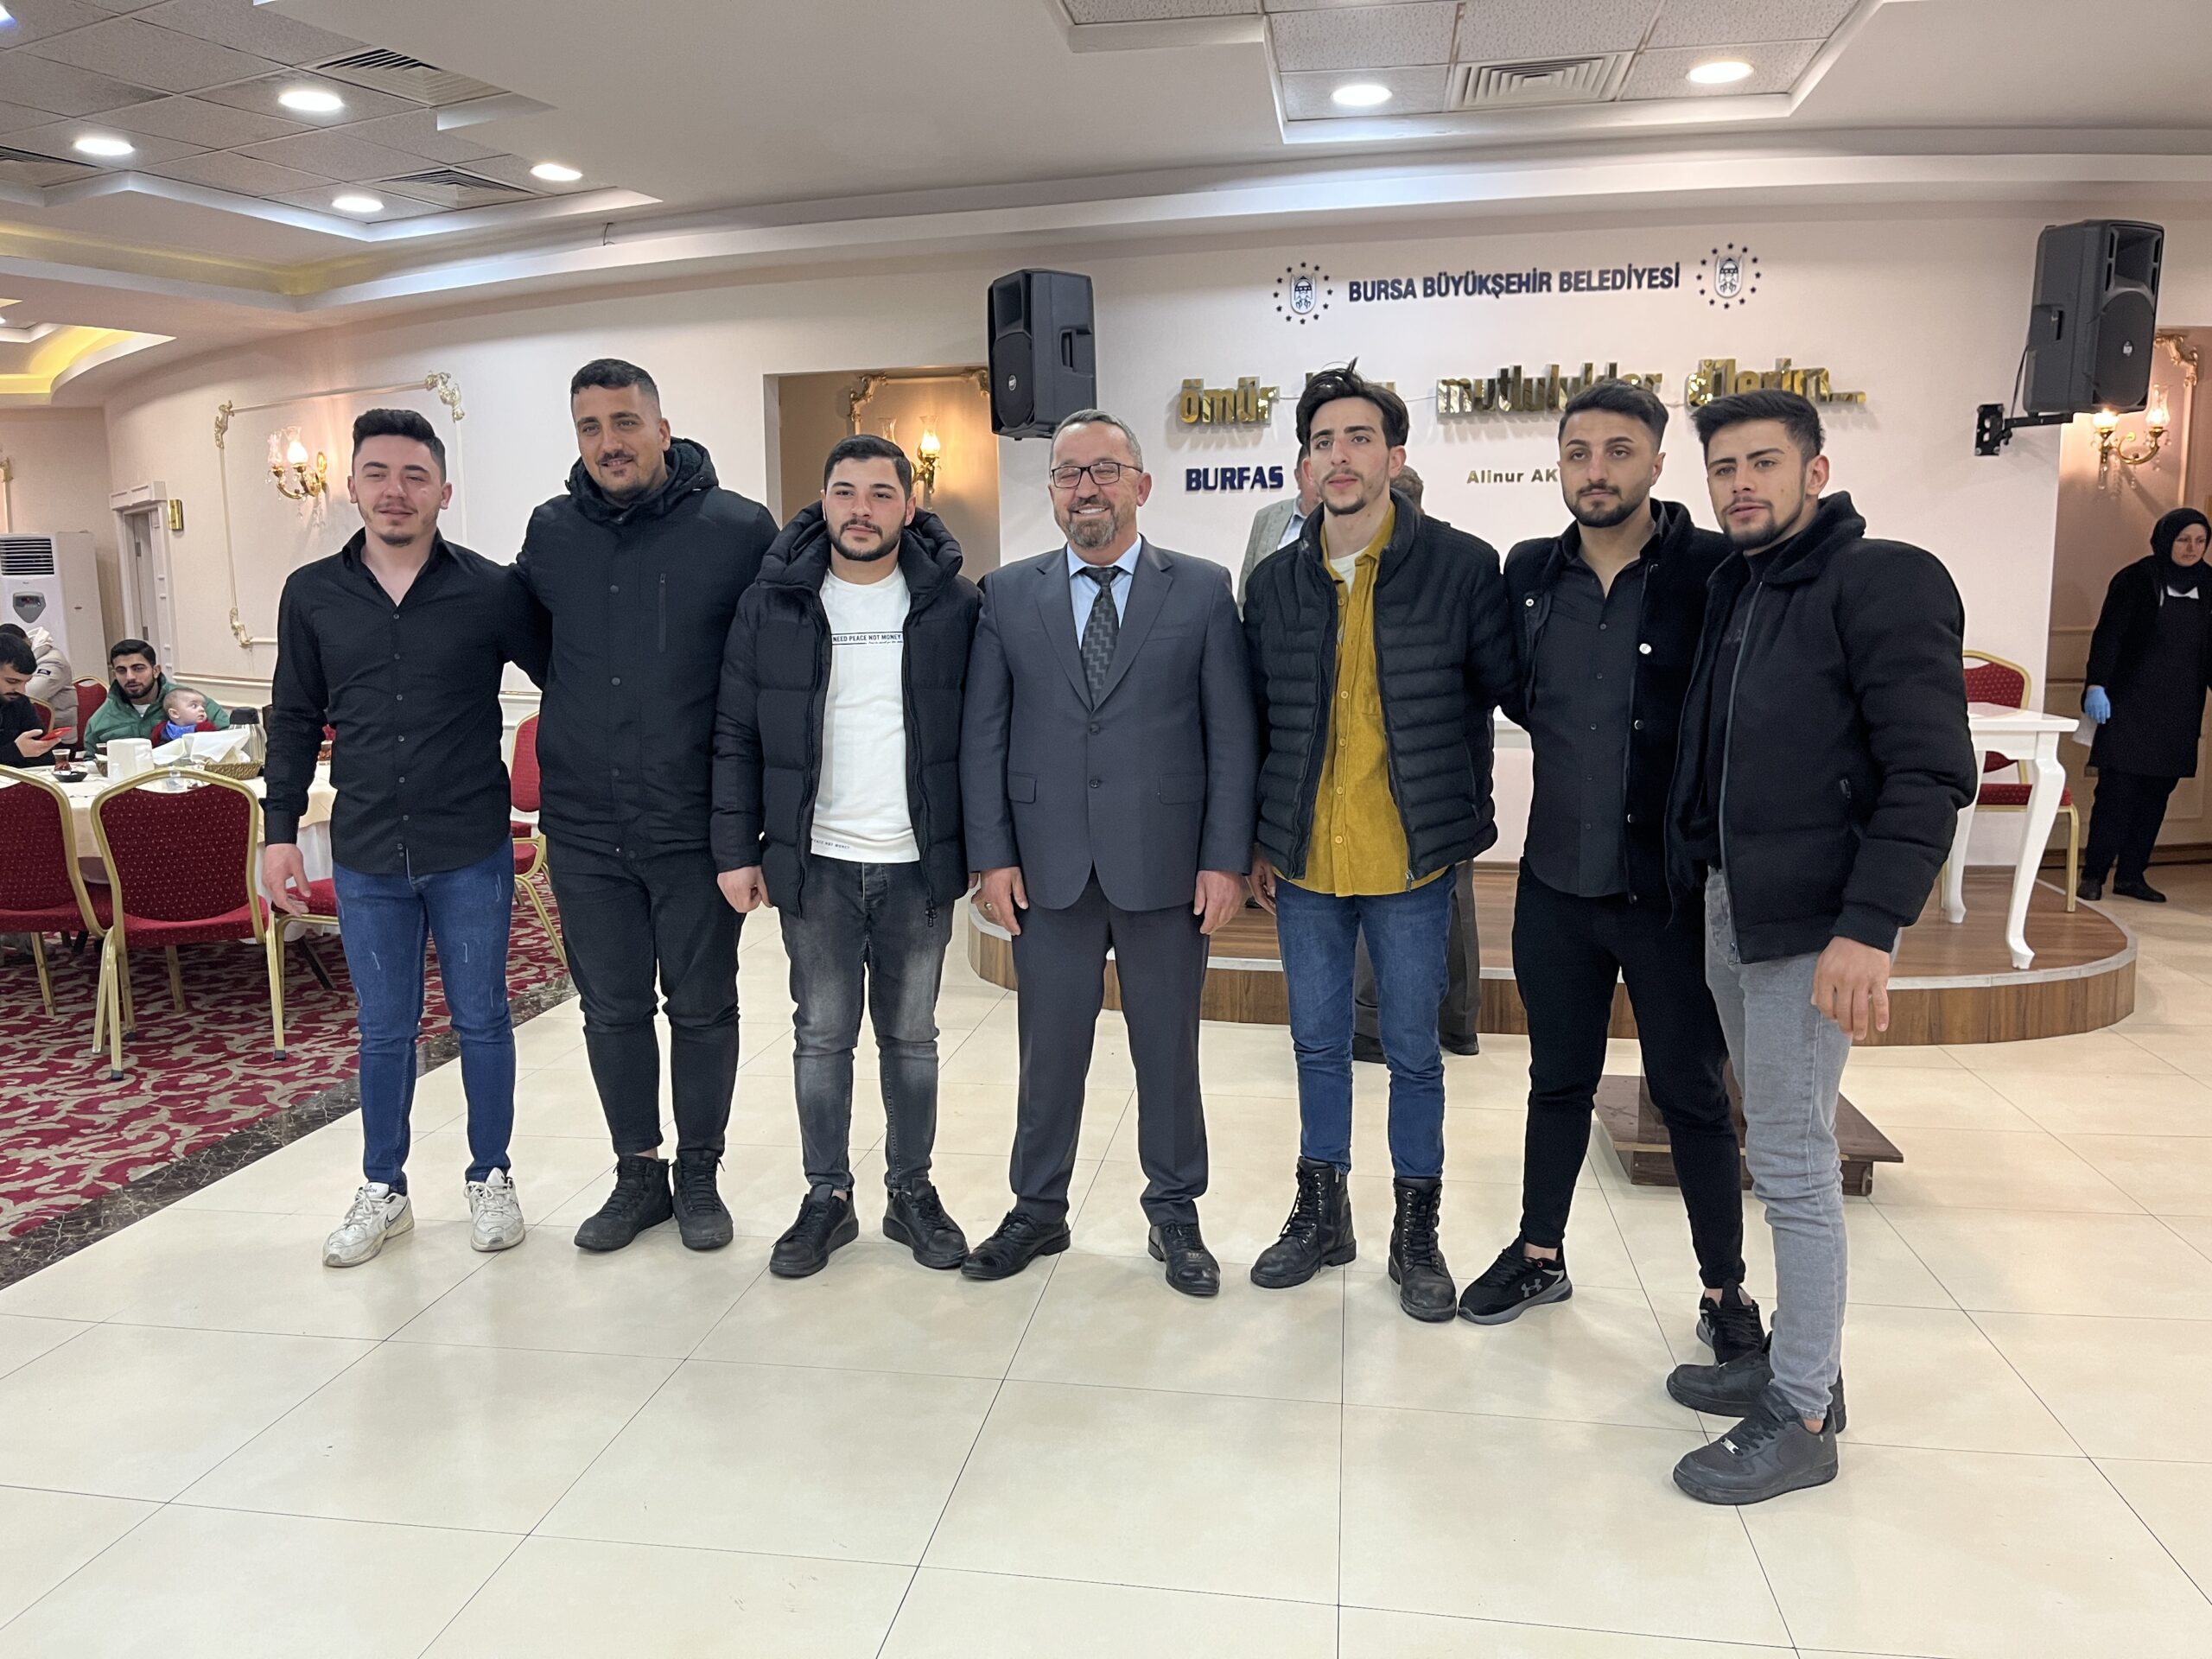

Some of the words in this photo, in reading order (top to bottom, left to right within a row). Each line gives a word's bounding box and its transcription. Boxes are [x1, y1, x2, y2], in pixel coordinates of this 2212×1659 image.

[1349, 277, 1417, 302] BURSA
[1423, 267, 1552, 299] BÜYÜKŞEHİR
[1559, 261, 1681, 293] BELEDİYESİ
[1179, 377, 1279, 425] ömür
[1185, 466, 1284, 491] BURFAS
[1466, 468, 1524, 484] Alinur
